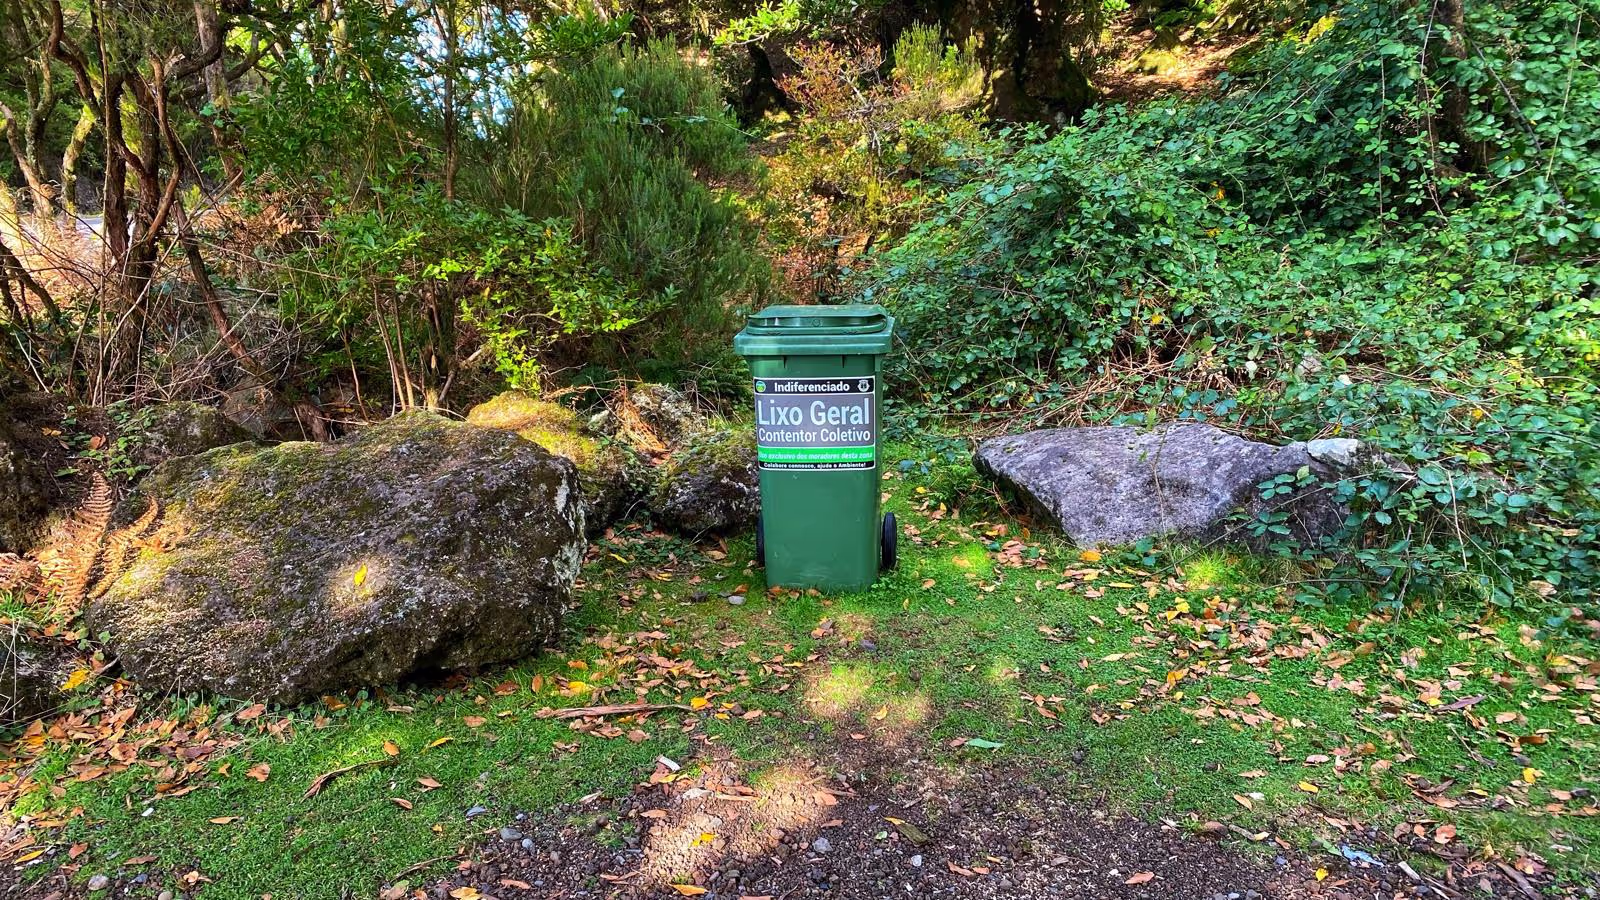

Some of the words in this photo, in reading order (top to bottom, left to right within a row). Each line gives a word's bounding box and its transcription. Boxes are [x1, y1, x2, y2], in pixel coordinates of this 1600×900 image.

[774, 381, 850, 392] Indiferenciado
[757, 399, 803, 425] Lixo
[810, 397, 870, 425] Geral
[758, 428, 817, 442] Contentor
[820, 427, 871, 441] Coletivo
[808, 452, 840, 460] moradores
[841, 451, 858, 459] desta
